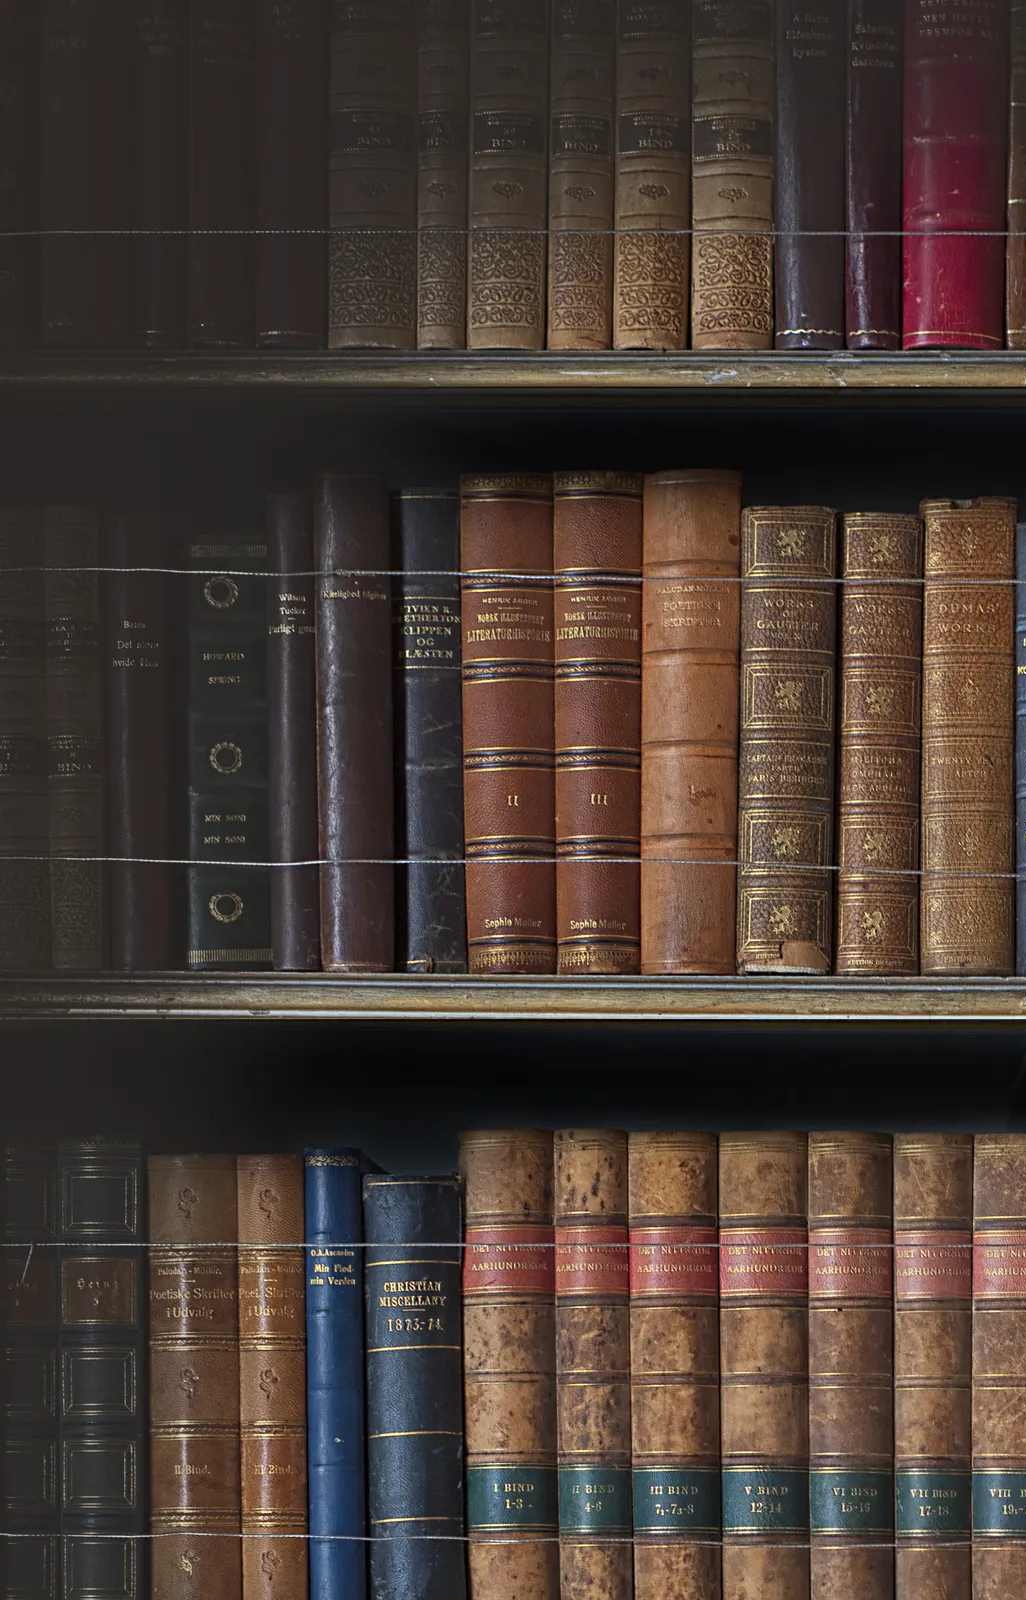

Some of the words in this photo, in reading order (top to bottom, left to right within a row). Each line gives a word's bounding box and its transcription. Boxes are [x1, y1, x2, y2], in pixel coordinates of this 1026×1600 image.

[279, 594, 306, 603] Wilson
[279, 607, 306, 616] Tucker
[938, 623, 995, 633] WORKS
[417, 638, 433, 646] OG
[203, 652, 244, 661] HOWARD
[208, 675, 241, 684] SPRING
[204, 814, 221, 823] MIN
[485, 917, 512, 928] Sophie
[384, 1281, 441, 1292] CHRISTIAN
[380, 1296, 446, 1307] MISCELLANY
[503, 1484, 534, 1492] BIND
[585, 1485, 615, 1493] BIND
[668, 1486, 697, 1495] BIND
[757, 1487, 787, 1496] BIND
[833, 1488, 845, 1496] VI
[850, 1488, 877, 1496] BIND
[933, 1489, 956, 1497] BIND
[989, 1489, 1010, 1497] VIII
[505, 1499, 523, 1508] 1-3
[750, 1503, 781, 1512] 12-14
